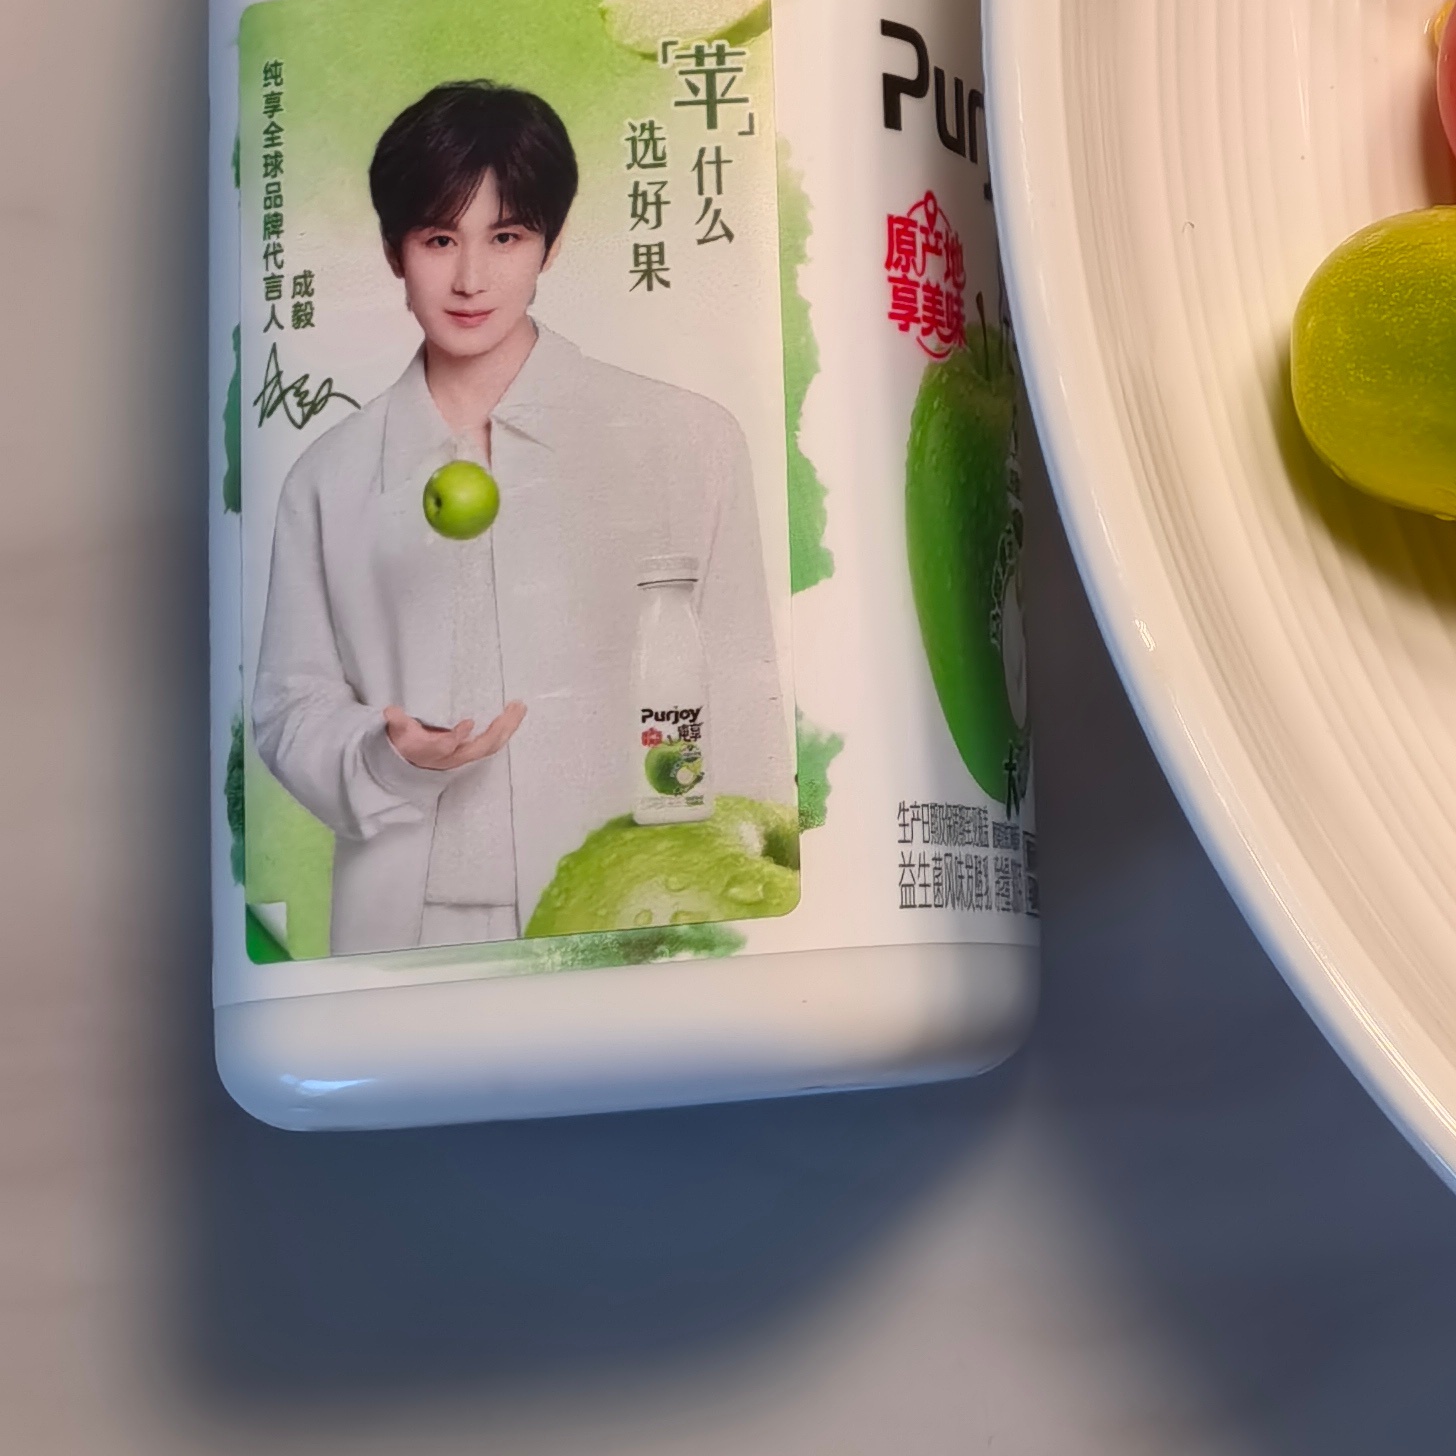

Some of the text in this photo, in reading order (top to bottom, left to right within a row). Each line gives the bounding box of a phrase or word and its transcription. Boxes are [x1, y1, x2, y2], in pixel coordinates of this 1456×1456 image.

[262, 59, 285, 333] 纯享全球品牌代言人
[625, 119, 671, 292] 选好果
[885, 213, 966, 290] 原产地
[291, 269, 315, 330] 成毅
[887, 274, 968, 348] 享美味
[641, 706, 703, 724] Purjoy
